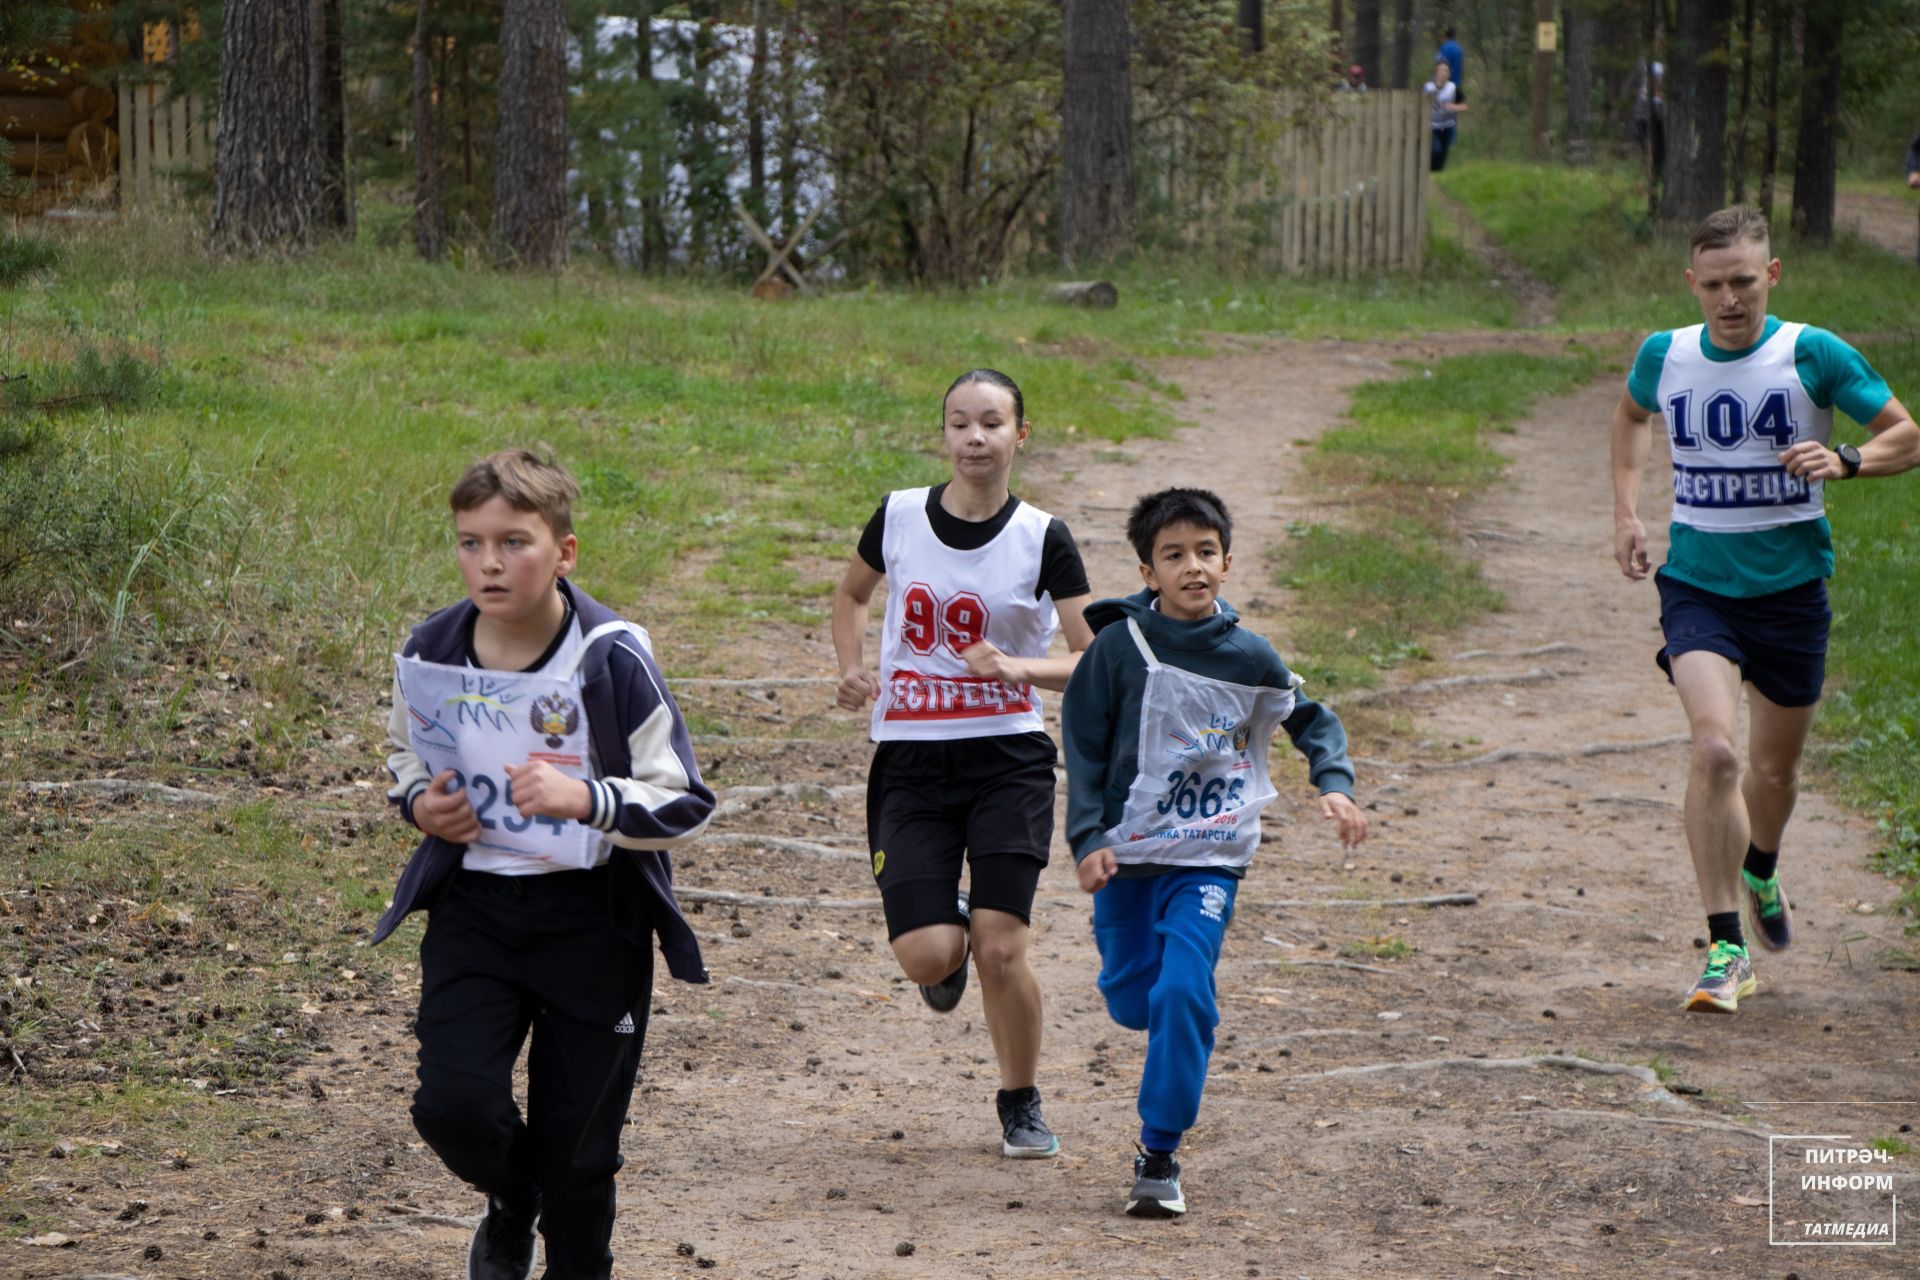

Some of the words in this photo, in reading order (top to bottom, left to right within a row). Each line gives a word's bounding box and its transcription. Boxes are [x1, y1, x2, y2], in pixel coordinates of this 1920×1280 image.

[1667, 388, 1798, 451] 104
[901, 581, 991, 660] 99
[1214, 815, 1238, 825] 2016
